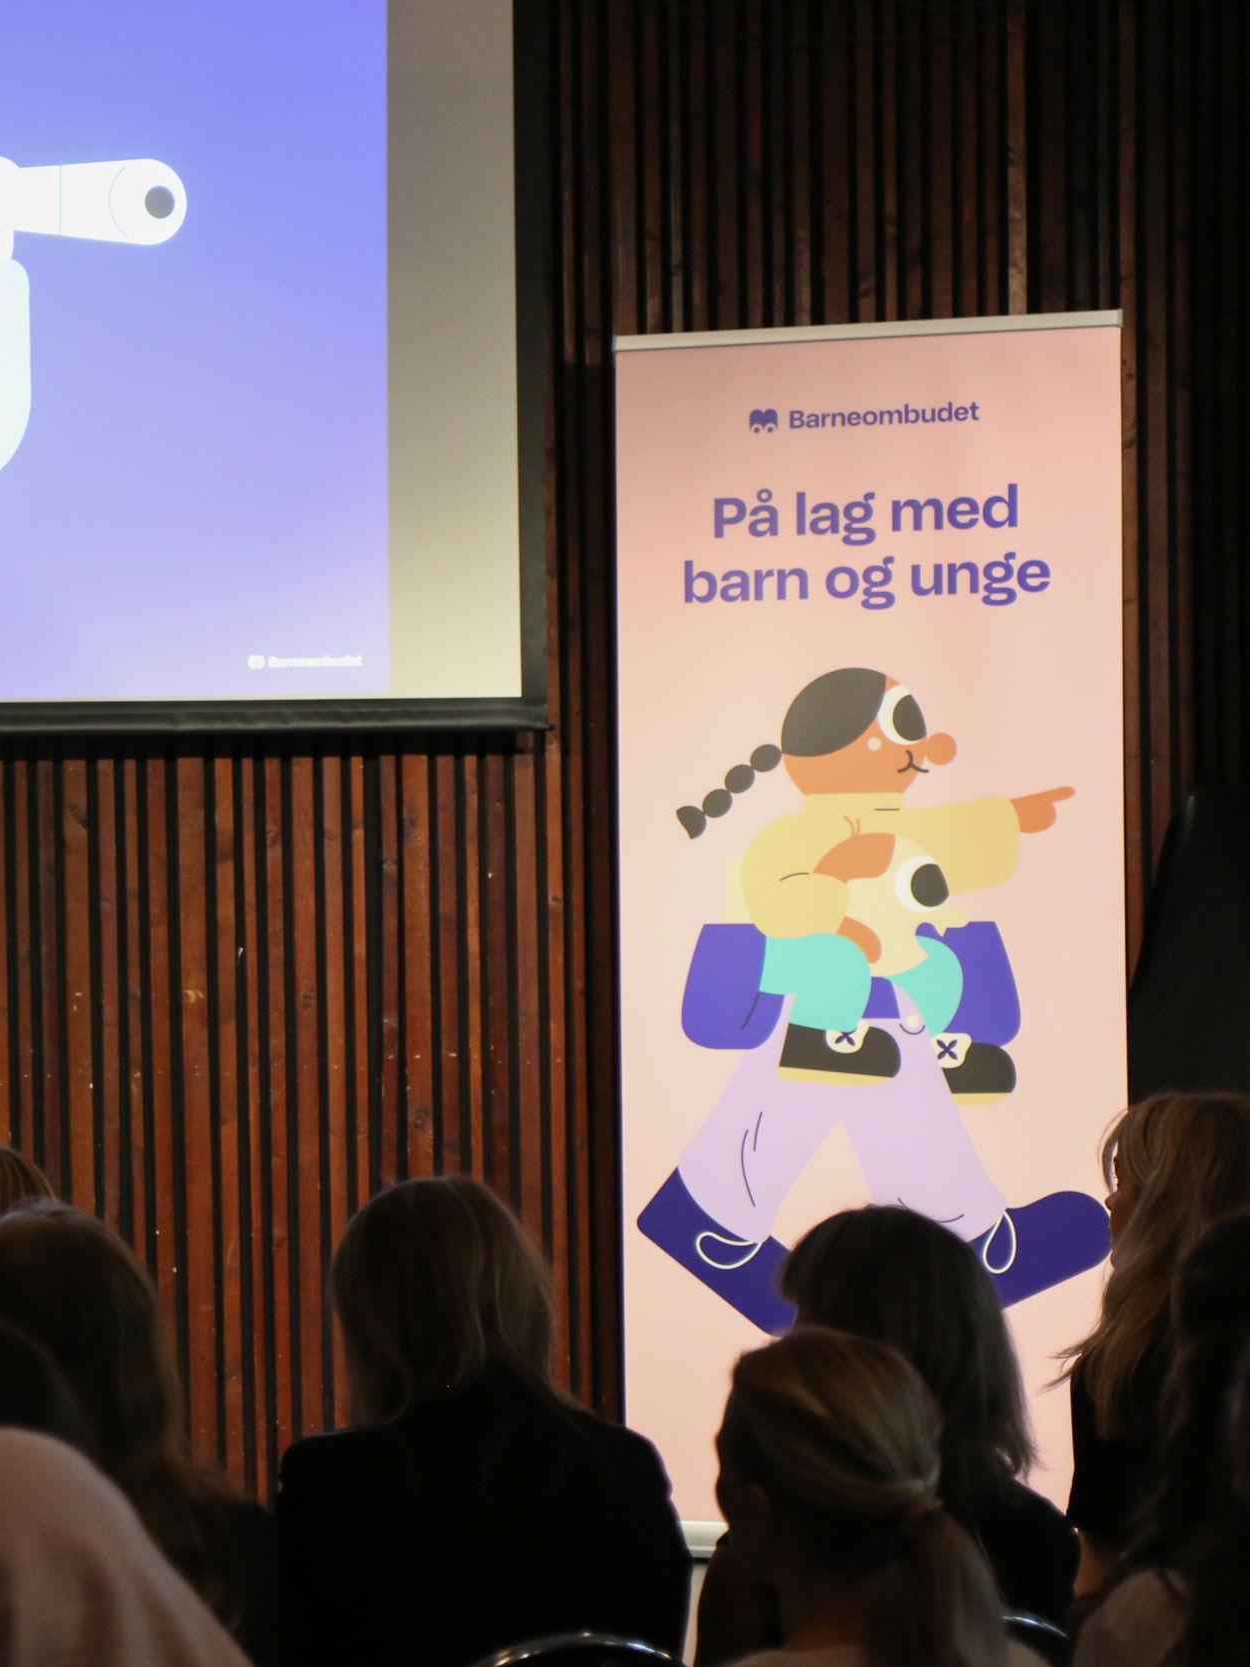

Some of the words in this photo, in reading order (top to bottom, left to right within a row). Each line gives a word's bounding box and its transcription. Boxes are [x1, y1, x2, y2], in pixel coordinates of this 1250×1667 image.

[789, 402, 980, 429] Barneombudet
[714, 488, 779, 539] På
[796, 491, 877, 546] lag
[892, 483, 1019, 532] med
[684, 560, 809, 604] barn
[825, 556, 896, 610] og
[911, 551, 1051, 607] unge
